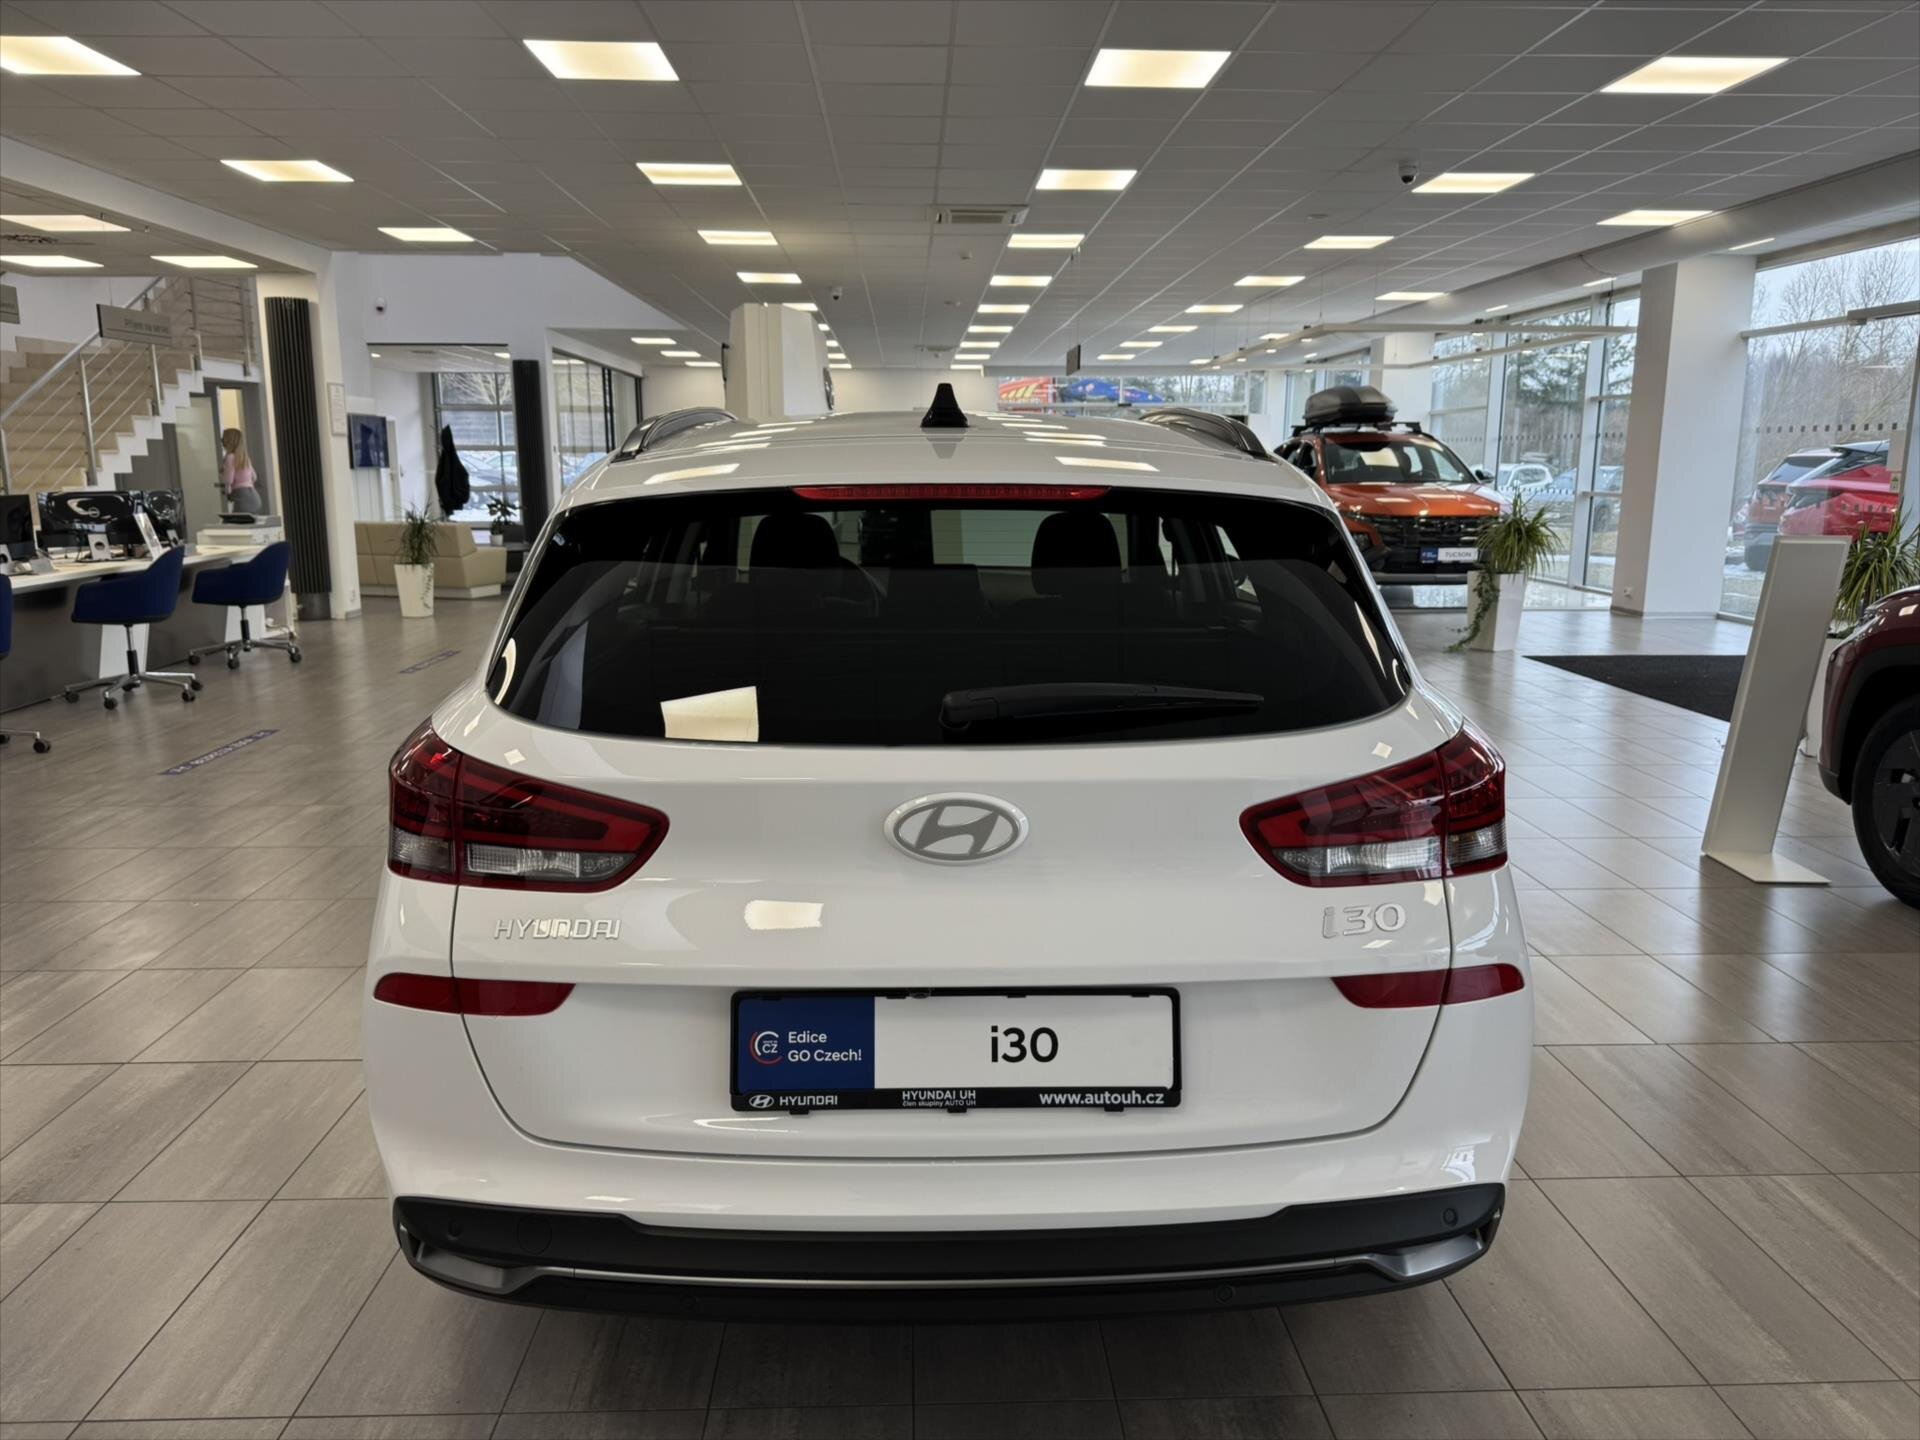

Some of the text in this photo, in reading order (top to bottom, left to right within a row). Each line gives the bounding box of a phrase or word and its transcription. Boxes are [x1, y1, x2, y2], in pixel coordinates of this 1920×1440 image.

[494, 919, 621, 940] HYUNDAI
[788, 1031, 827, 1043] Edice
[991, 1025, 1058, 1062] i30
[788, 1049, 862, 1062] GO Czech!
[780, 1095, 838, 1106] HYUNDAI
[902, 1090, 976, 1100] HYUNDAI UH
[1039, 1090, 1165, 1105] www.autouh.cz
